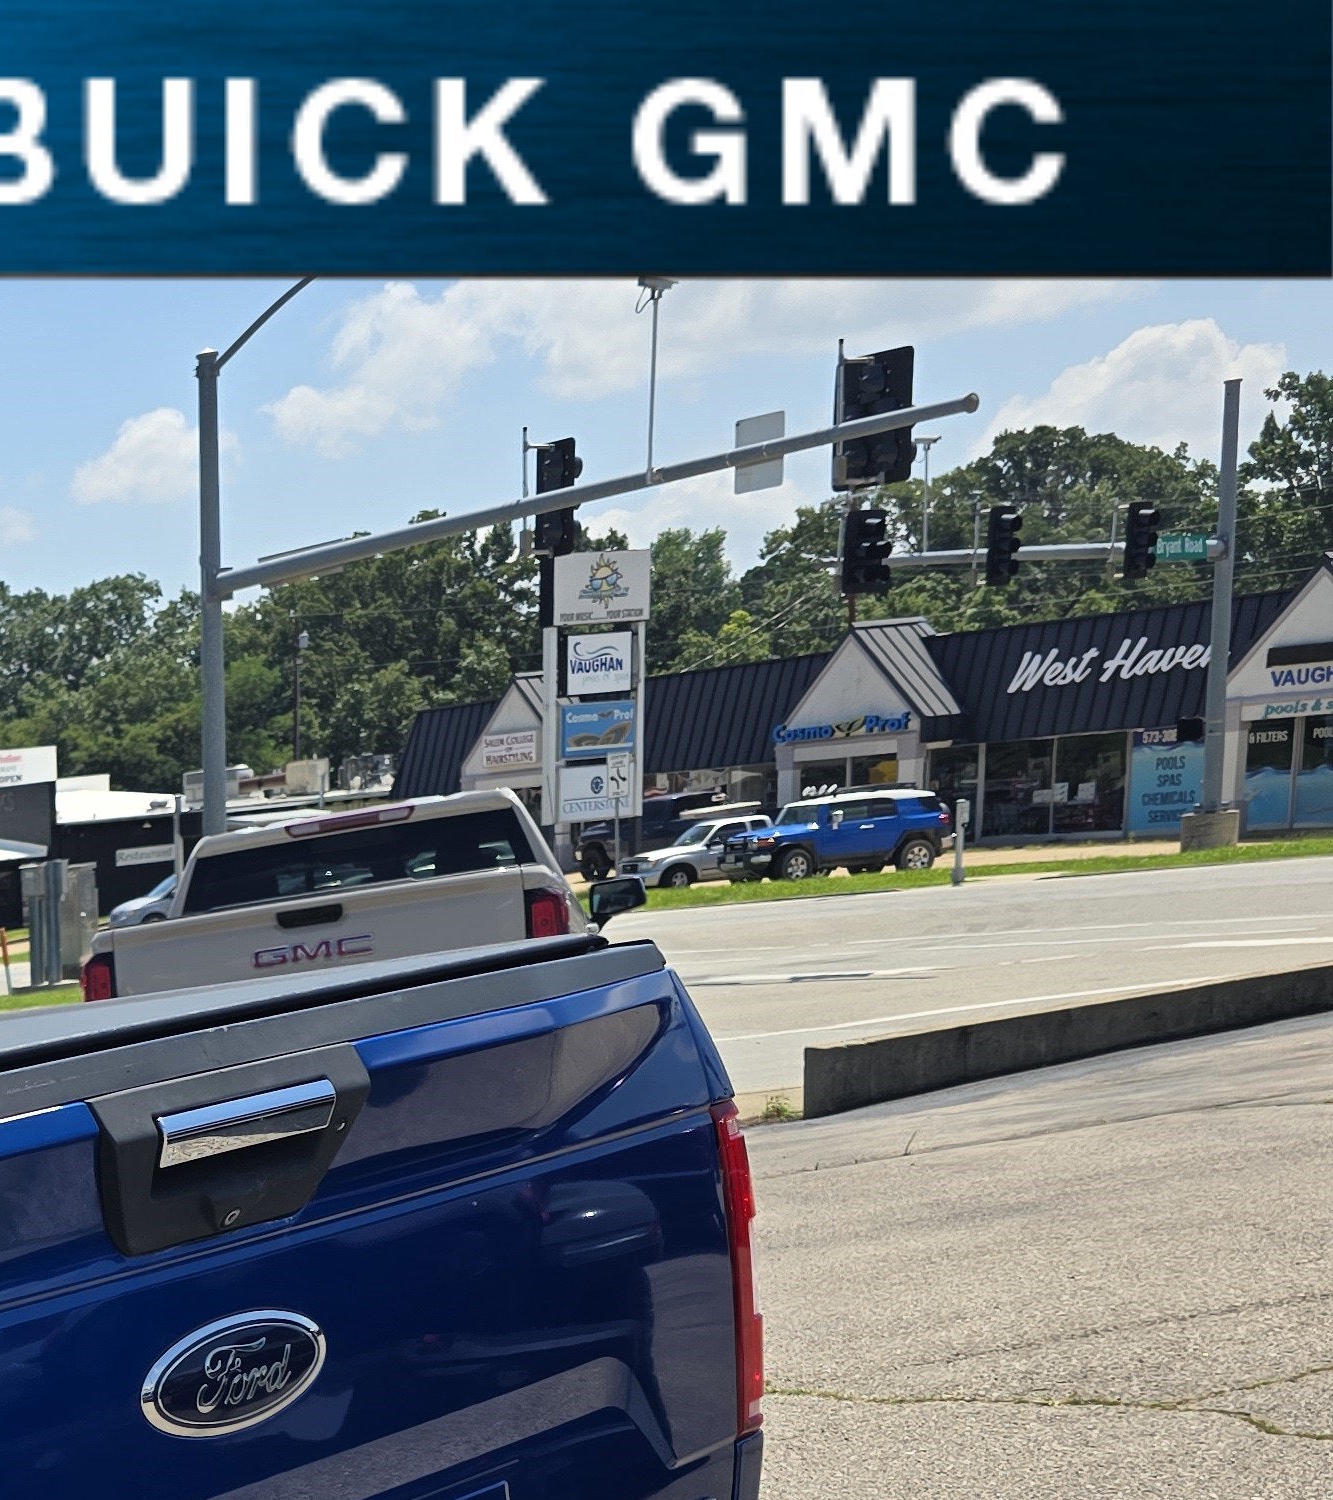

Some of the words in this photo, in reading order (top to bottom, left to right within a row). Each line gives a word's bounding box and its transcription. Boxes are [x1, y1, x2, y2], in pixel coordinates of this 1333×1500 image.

[1156, 538, 1182, 557] Bryant
[1184, 537, 1203, 553] Road
[569, 656, 624, 675] VAUGHAN
[1006, 646, 1101, 694] West
[1261, 700, 1309, 720] pools
[773, 724, 836, 744] Cosmo
[863, 711, 912, 734] Prof
[1256, 730, 1289, 744] FILTERS
[1155, 756, 1187, 771] POOLS
[1156, 774, 1183, 788] SPAS
[253, 933, 374, 969] GMC
[196, 1336, 293, 1415] Ford
